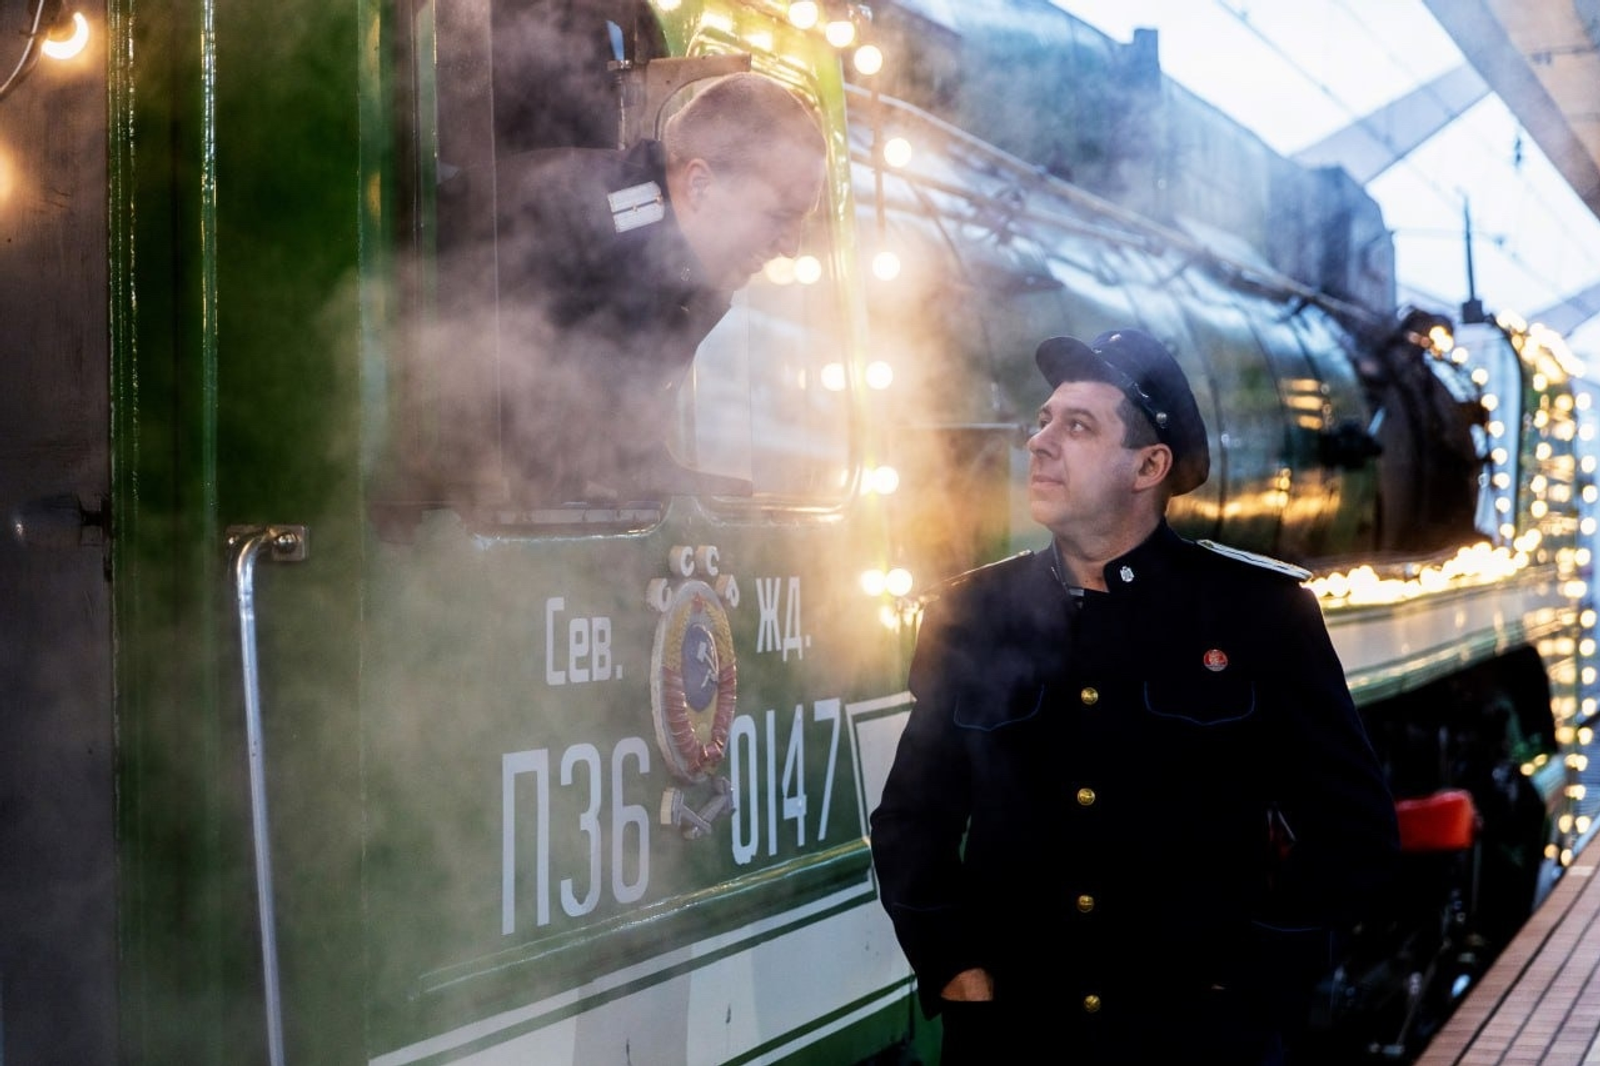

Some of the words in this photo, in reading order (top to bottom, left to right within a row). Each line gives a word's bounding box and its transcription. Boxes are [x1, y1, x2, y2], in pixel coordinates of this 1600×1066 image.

[546, 597, 622, 685] Сев.
[502, 737, 650, 935] П36
[730, 698, 840, 865] 0147
